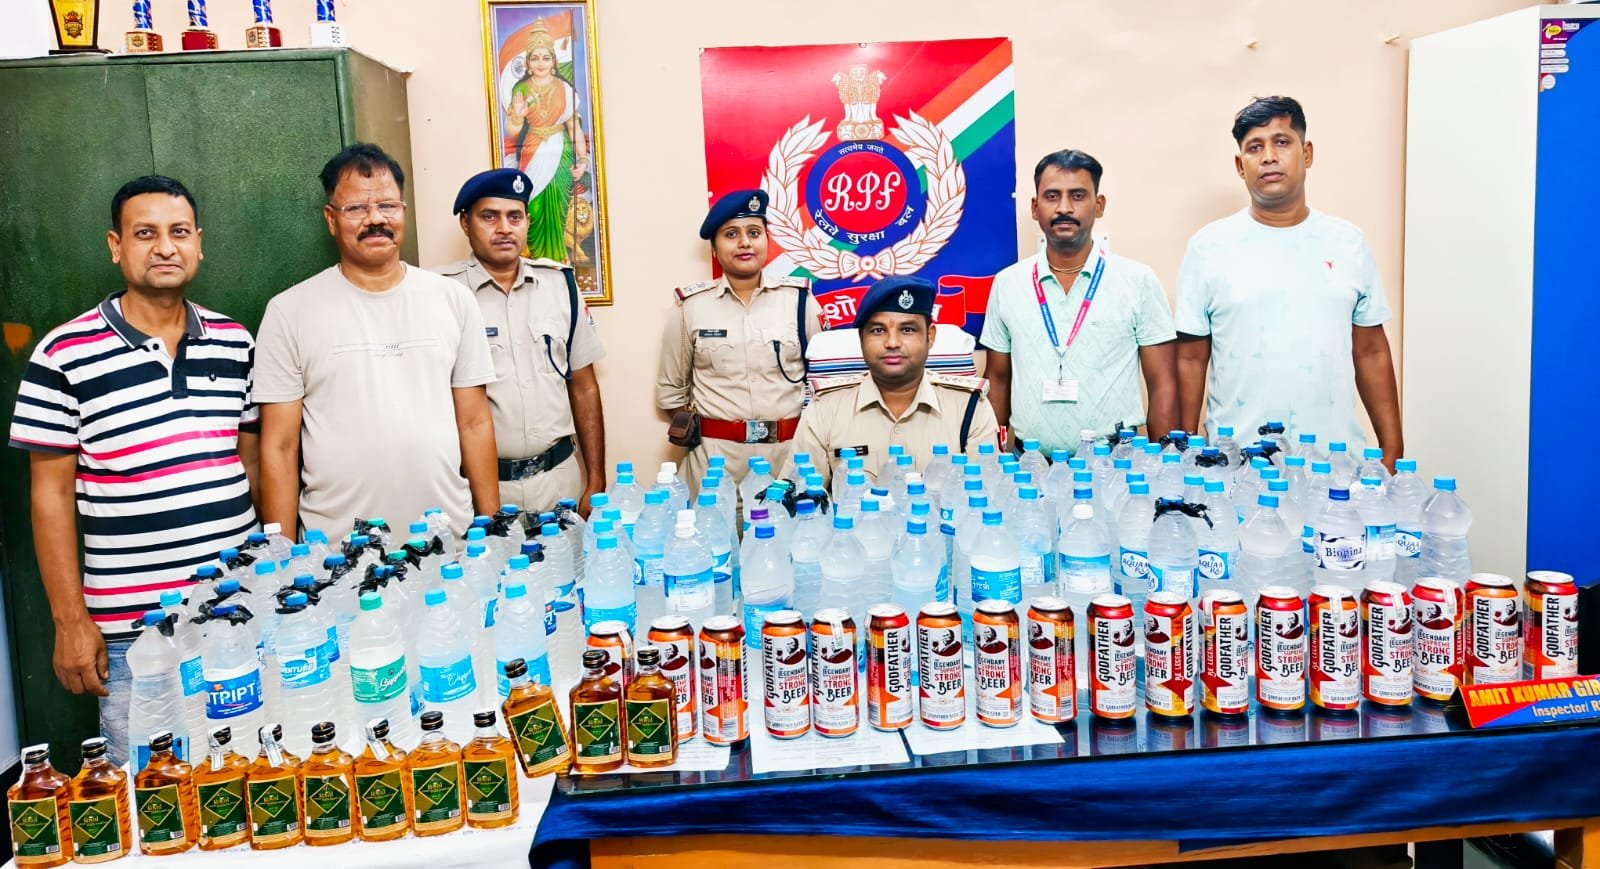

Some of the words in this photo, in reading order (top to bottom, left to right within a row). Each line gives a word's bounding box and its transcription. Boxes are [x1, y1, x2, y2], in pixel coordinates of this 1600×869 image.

[838, 142, 863, 155] सत्यमेव
[866, 144, 884, 155] जयते
[847, 230, 885, 245] सुरक्षा
[895, 205, 914, 226] बल
[1476, 598, 1496, 659] GODFATHER
[1546, 597, 1565, 658] GODFATHER
[1261, 610, 1278, 672] GODFATHER
[1371, 607, 1390, 668] GODFATHER
[1098, 621, 1116, 682] GODFATHER
[1220, 617, 1238, 679] GODFATHER
[1495, 642, 1518, 651] STRON
[887, 631, 904, 693] GODFATHER
[1390, 651, 1412, 659] STRON
[1420, 651, 1450, 665] BEER
[1498, 650, 1517, 664] BEE
[764, 637, 780, 699] GODFATHER
[1031, 663, 1052, 675] TRONG
[1146, 658, 1168, 670] TRONG
[1393, 658, 1412, 673] BEE
[980, 676, 1006, 690] BEER
[1118, 670, 1135, 686] BEE
[826, 687, 852, 702] BEER
[937, 679, 962, 695] BEER
[1468, 687, 1510, 707] AMIT
[1512, 681, 1573, 703] KUMAR
[782, 687, 807, 704] BEER
